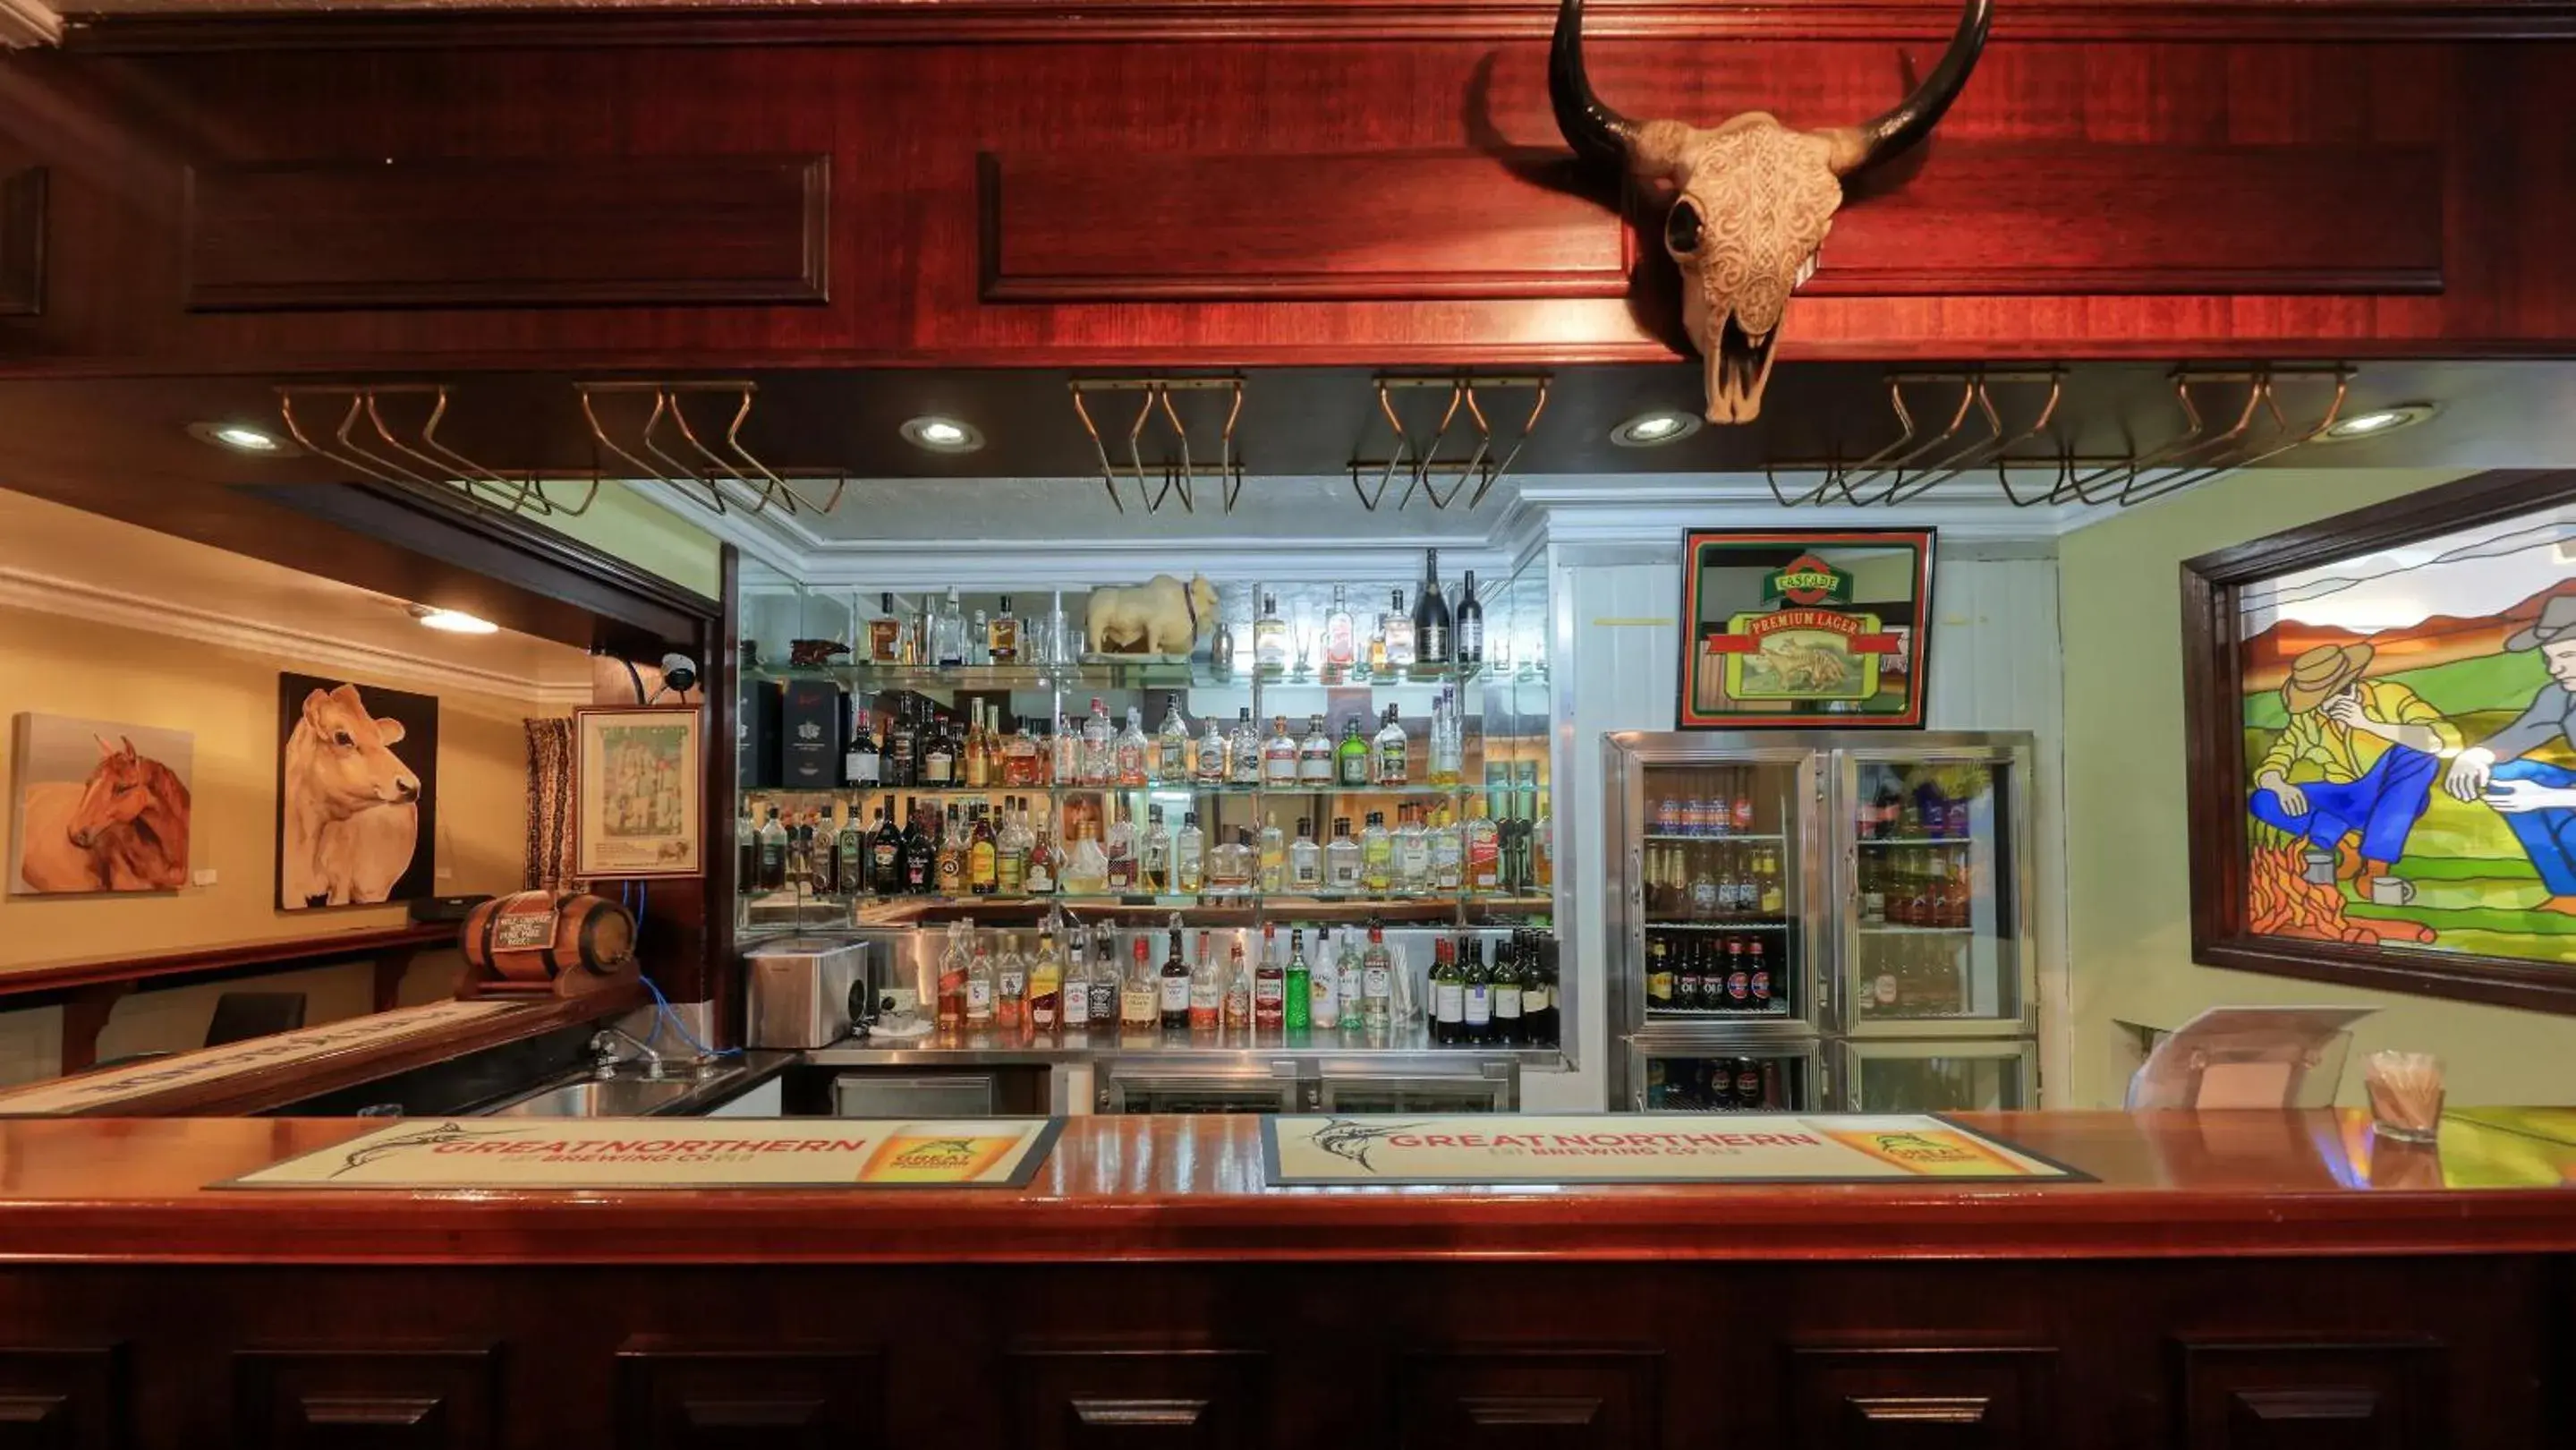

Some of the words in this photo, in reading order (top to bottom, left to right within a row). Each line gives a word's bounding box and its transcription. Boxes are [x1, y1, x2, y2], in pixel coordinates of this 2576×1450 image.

[1753, 612, 1815, 634] PREMIUM
[1815, 612, 1858, 634] LAGER
[432, 1139, 601, 1153] GREAT
[599, 1139, 867, 1152] NORTHERN
[1388, 1134, 1545, 1146] GREAT
[1553, 1133, 1821, 1146] NORTHERN
[541, 1154, 671, 1162] BREWING
